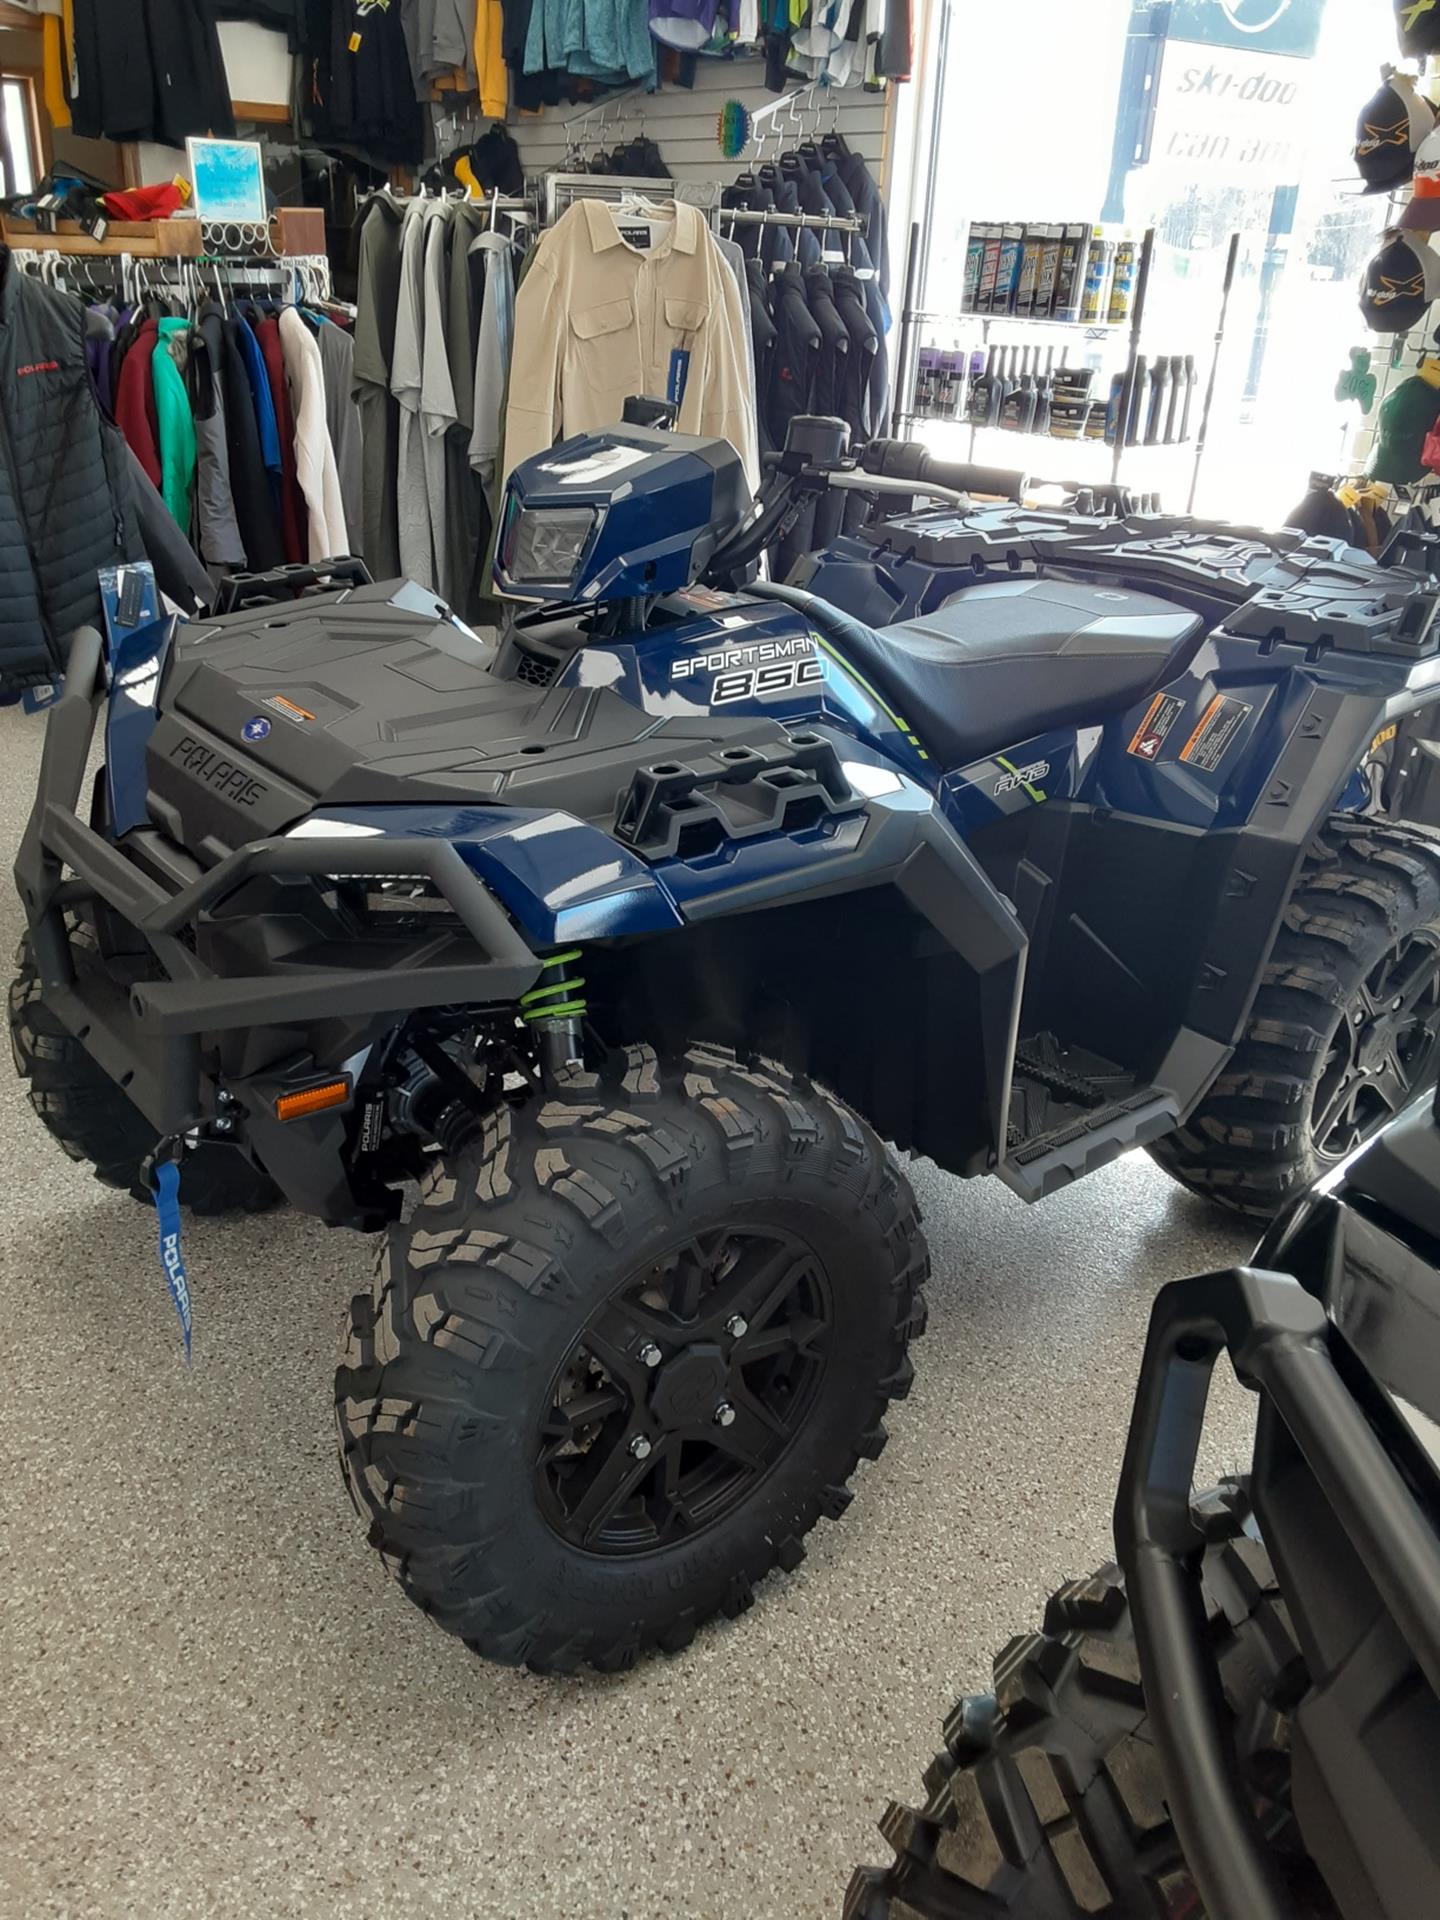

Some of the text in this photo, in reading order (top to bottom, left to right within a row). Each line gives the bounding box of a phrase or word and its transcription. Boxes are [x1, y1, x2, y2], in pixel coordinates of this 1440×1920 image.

[1176, 64, 1298, 105] ski-doo
[674, 359, 682, 402] POLARIS
[671, 637, 819, 679] SPORTSMAN
[711, 655, 829, 706] 850
[169, 736, 268, 807] POLARIS
[993, 763, 1050, 797] AWD
[361, 1103, 373, 1152] POLARIS
[162, 1232, 192, 1332] POLARIS
